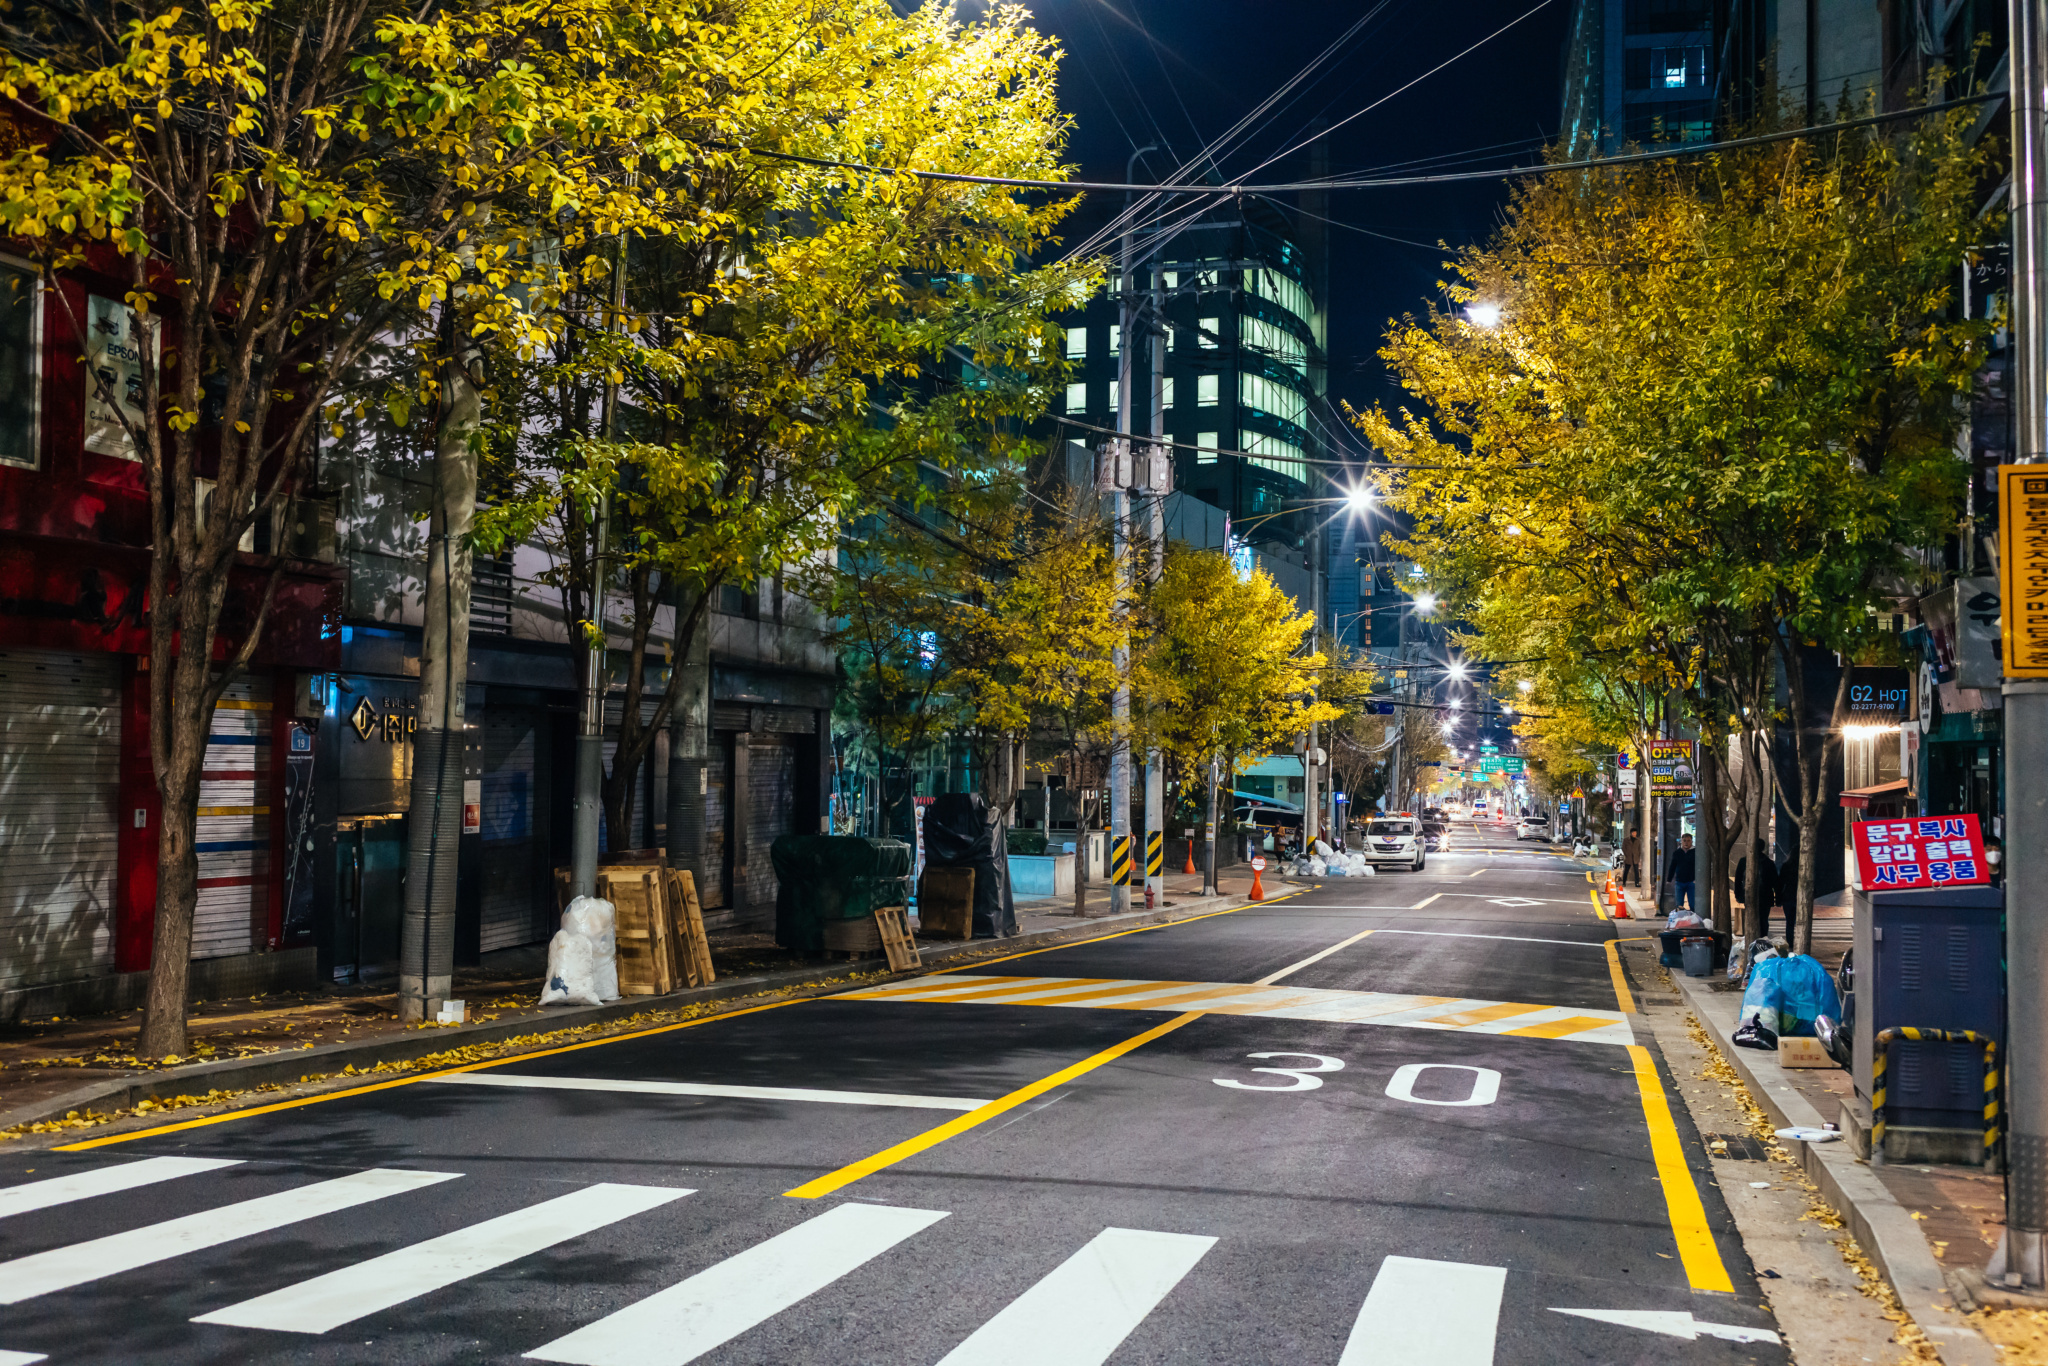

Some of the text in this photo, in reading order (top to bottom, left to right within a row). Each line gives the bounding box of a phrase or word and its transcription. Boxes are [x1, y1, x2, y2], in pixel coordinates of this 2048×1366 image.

[107, 343, 140, 361] EPSON
[1850, 685, 1908, 702] G2 HOT
[296, 738, 306, 748] 19
[1651, 747, 1691, 759] OPEN
[1868, 839, 1973, 864] 칼라 출력
[1872, 859, 1978, 884] 사무 용품
[1212, 1051, 1503, 1107] 30
